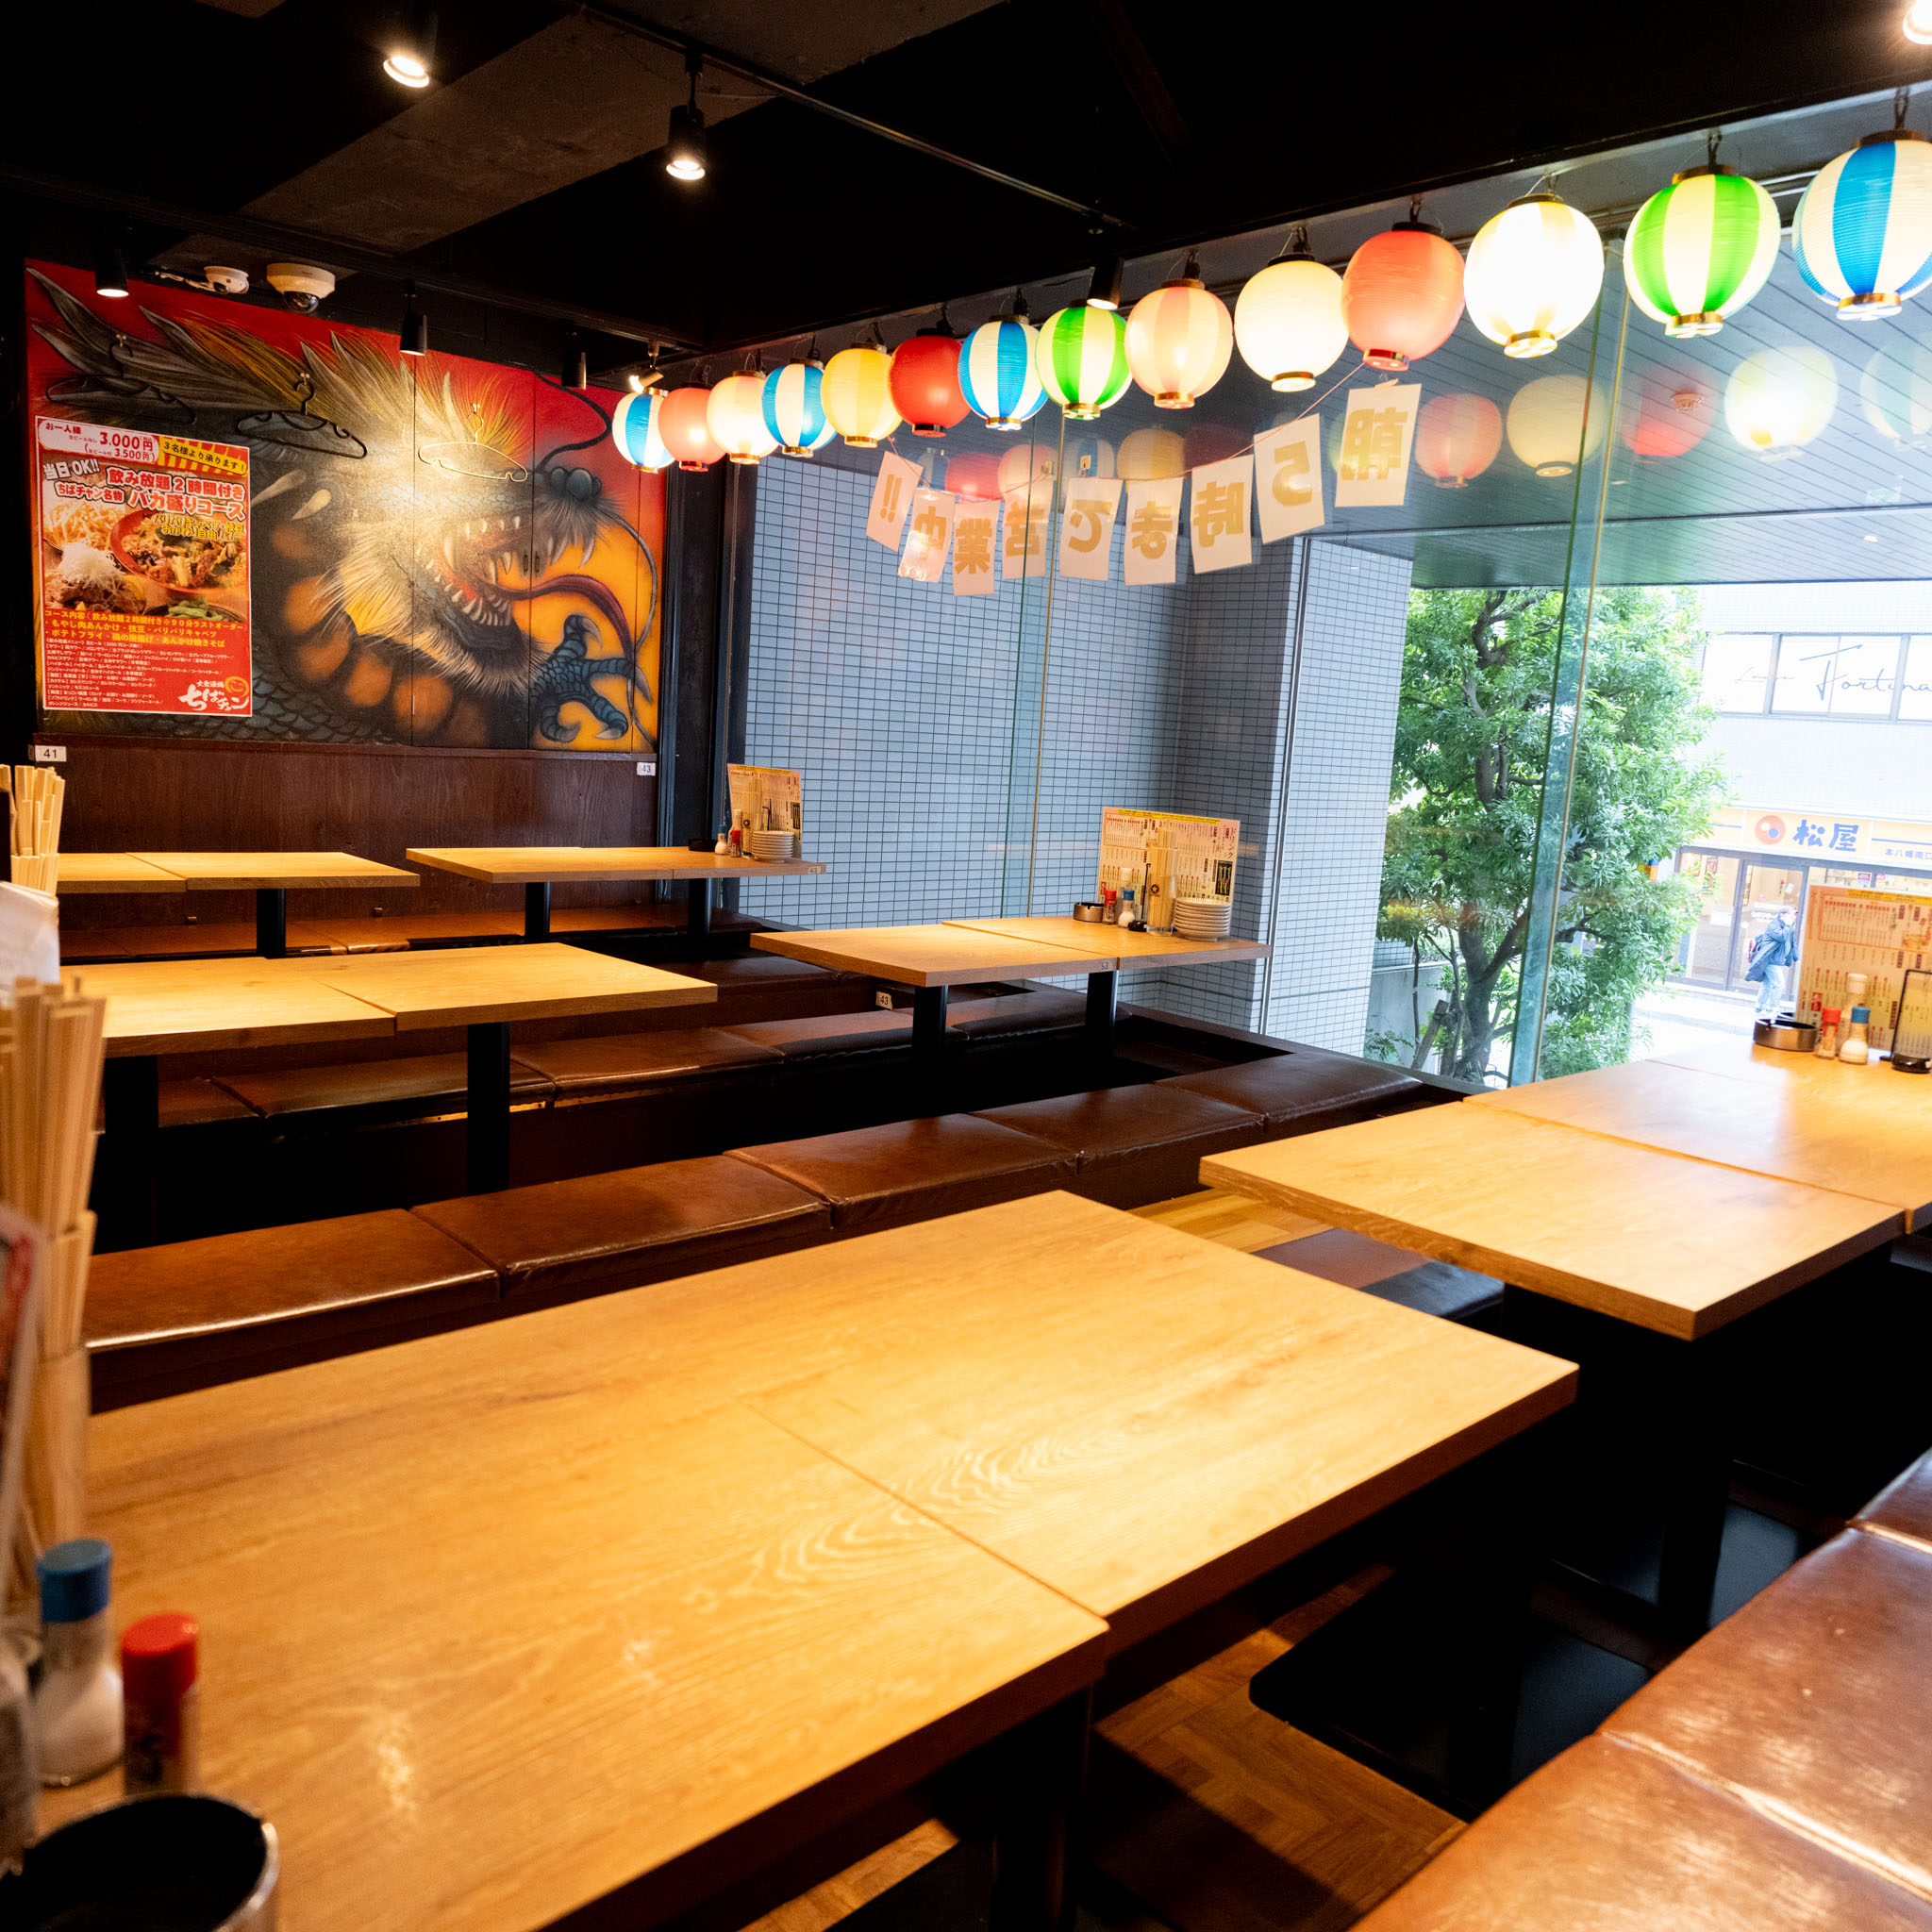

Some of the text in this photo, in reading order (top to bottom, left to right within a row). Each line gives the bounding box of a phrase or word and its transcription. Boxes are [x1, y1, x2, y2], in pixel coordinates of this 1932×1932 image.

[45, 423, 81, 434] お一人様
[164, 441, 244, 471] 3名様より承ります!
[108, 468, 245, 501] 飲み放題2時間付き
[129, 489, 246, 521] バカ盛りコース
[43, 749, 58, 758] 41
[1792, 819, 1859, 853] 松屋
